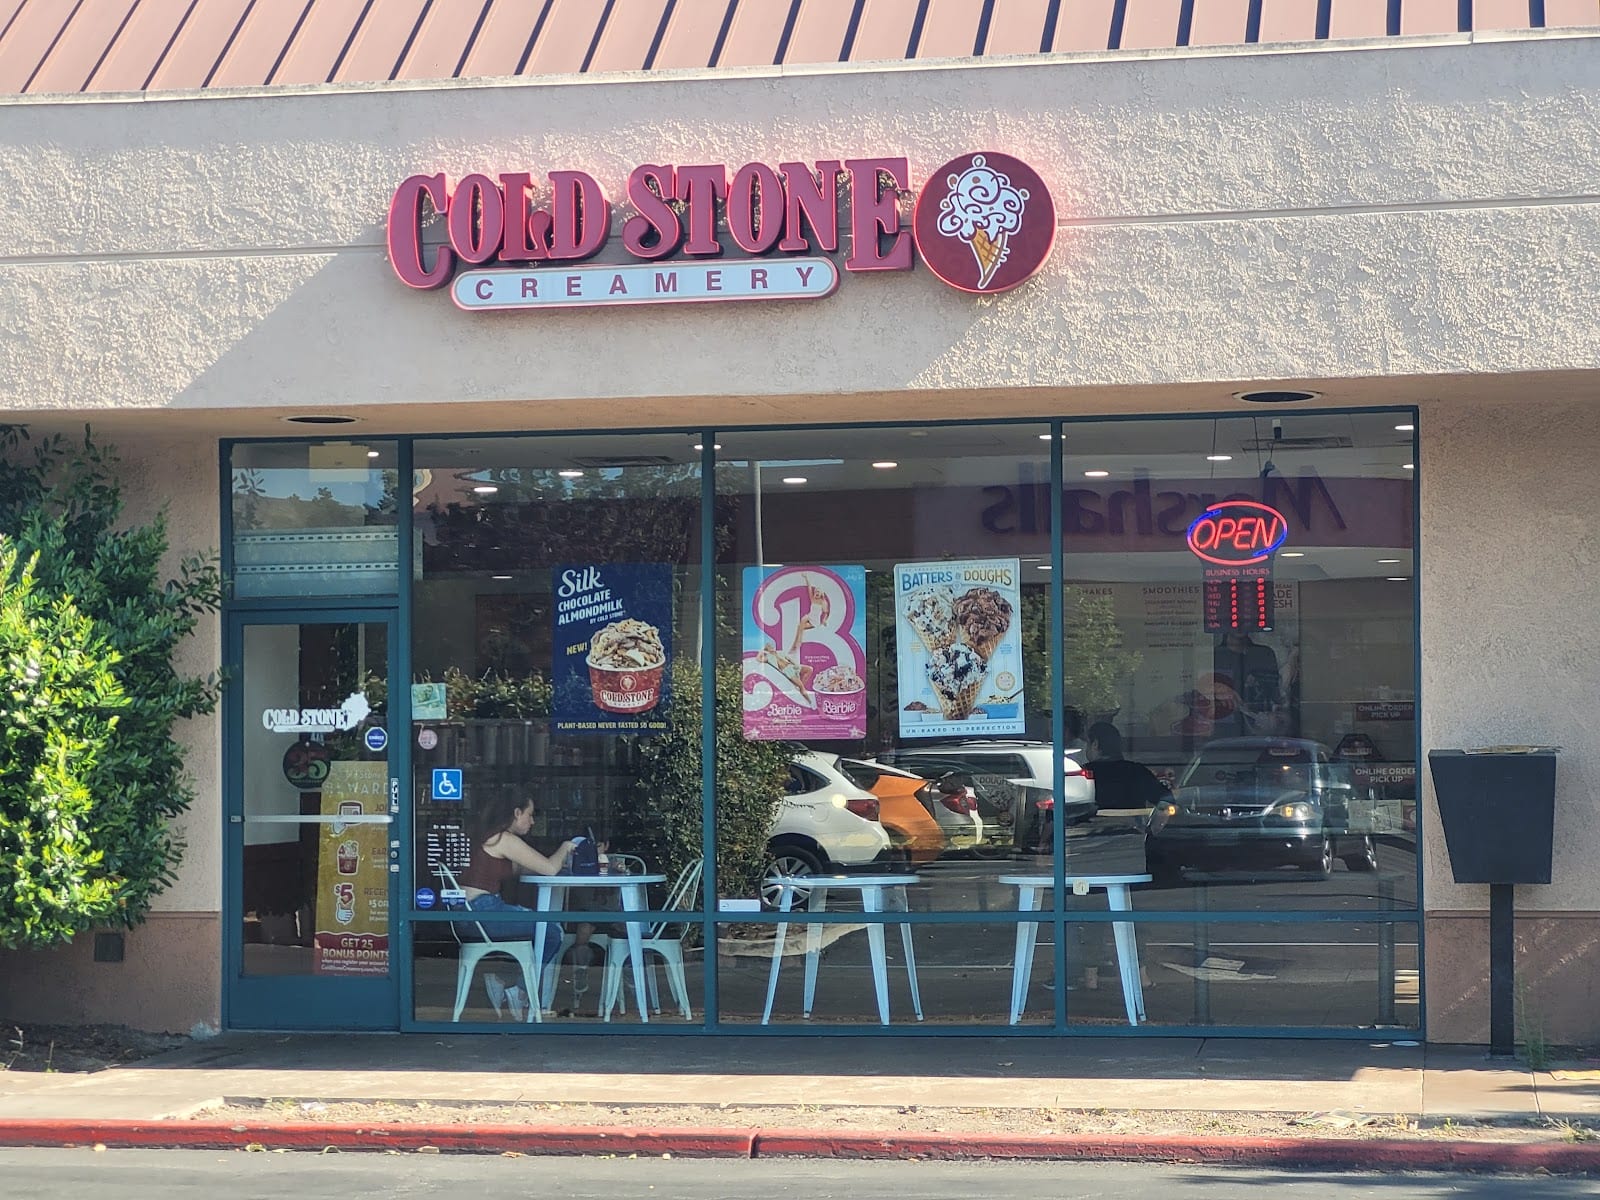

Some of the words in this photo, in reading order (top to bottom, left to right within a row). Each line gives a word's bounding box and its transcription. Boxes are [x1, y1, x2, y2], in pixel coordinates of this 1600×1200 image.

[386, 170, 608, 289] COLD
[622, 157, 914, 272] STONE
[475, 266, 814, 300] CREAMERY
[1193, 517, 1278, 550] OPEN
[558, 566, 605, 597] Silk
[902, 571, 953, 591] BATTERS
[963, 569, 1012, 586] DOUGHS
[1205, 569, 1240, 577] BUSINESS
[1242, 568, 1270, 576] HOURS
[1143, 586, 1200, 594] SMOOTHIES
[558, 589, 611, 612] CHOCOLATE
[558, 598, 623, 625] ALMONDMILK
[566, 642, 588, 655] NEW!
[767, 704, 802, 716] Barbie
[823, 700, 856, 714] Barbie
[262, 708, 300, 730] COLD
[301, 708, 349, 730] STONE
[1391, 775, 1403, 783] UP
[341, 938, 359, 948] GET
[361, 939, 374, 949] 25
[322, 948, 355, 959] BONUS
